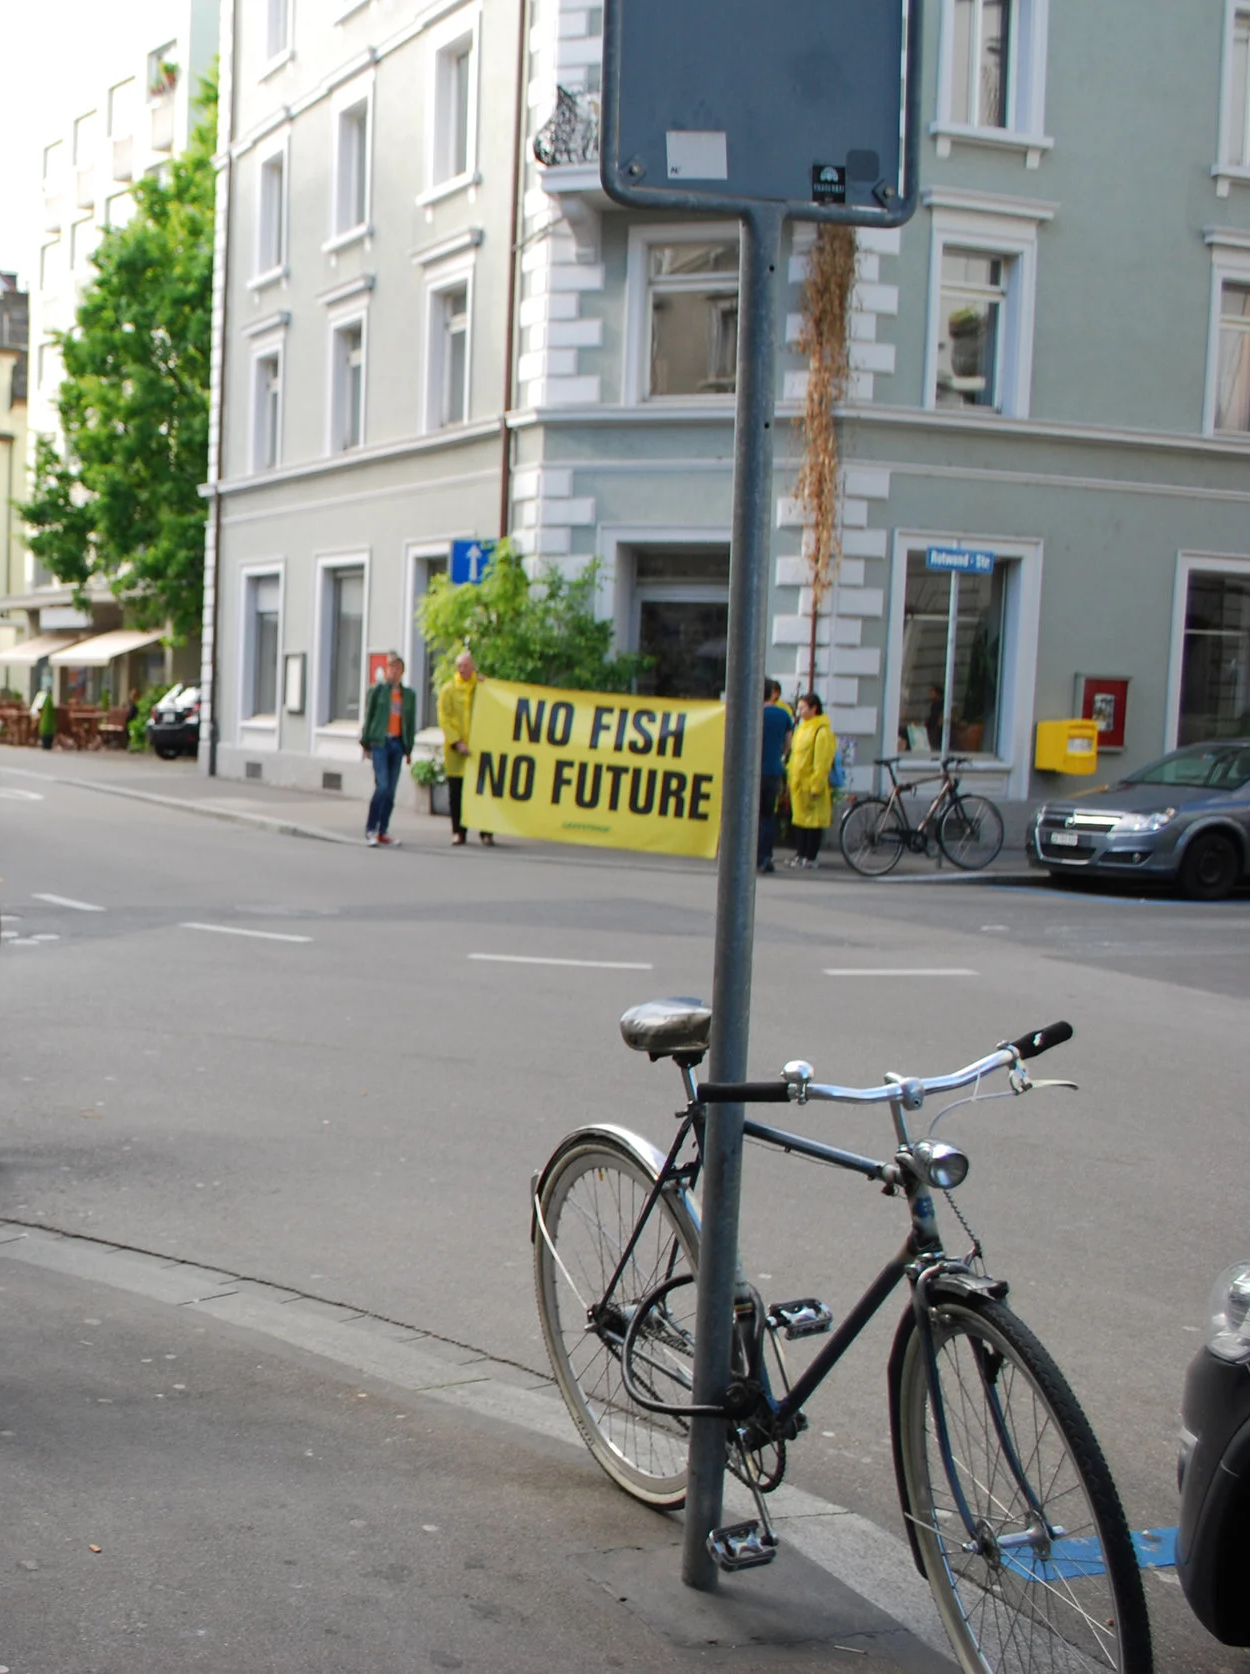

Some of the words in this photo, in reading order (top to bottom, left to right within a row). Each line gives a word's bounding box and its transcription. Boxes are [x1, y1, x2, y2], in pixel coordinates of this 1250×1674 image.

[512, 697, 575, 747] NO
[589, 705, 687, 758] FISH
[475, 751, 536, 802] NO
[550, 759, 714, 822] FUTURE
